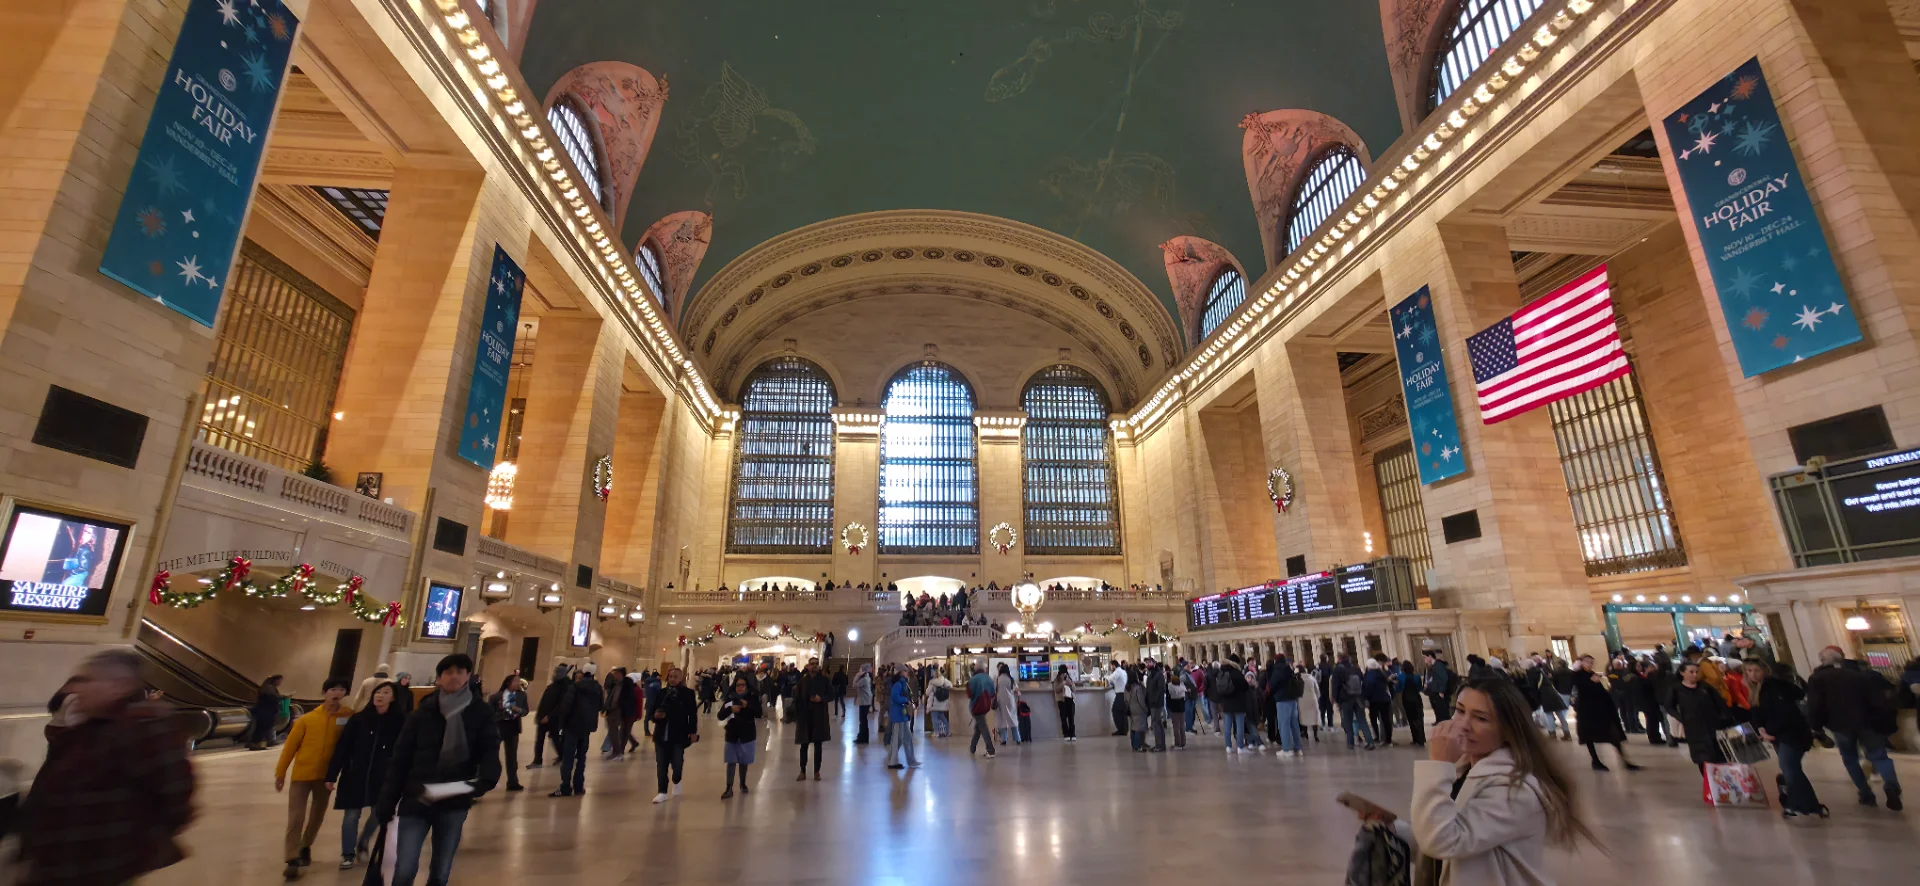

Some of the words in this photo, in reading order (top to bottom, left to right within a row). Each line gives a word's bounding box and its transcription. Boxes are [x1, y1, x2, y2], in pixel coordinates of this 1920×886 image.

[175, 68, 257, 144] HOLIDAY
[192, 104, 232, 148] FAIR
[1703, 172, 1789, 229] HOLIDAY
[1728, 201, 1773, 231] FAIR
[1720, 233, 1773, 262] VANDERBILT
[1776, 220, 1800, 236] HALL
[1724, 238, 1743, 252] NOV
[1744, 233, 1754, 242] 10
[1761, 220, 1780, 235] DEC
[482, 330, 510, 360] HOLIDAY
[487, 347, 502, 365] FAIR
[1405, 361, 1440, 387] HOLIDAY
[1416, 376, 1433, 392] FAIR
[157, 558, 183, 573] THE
[186, 550, 239, 567] METLIFE
[241, 550, 290, 562] BUILDING
[11, 580, 88, 598] SAPPHIRE
[340, 566, 368, 586] STRT
[11, 593, 81, 609] RESERVE
